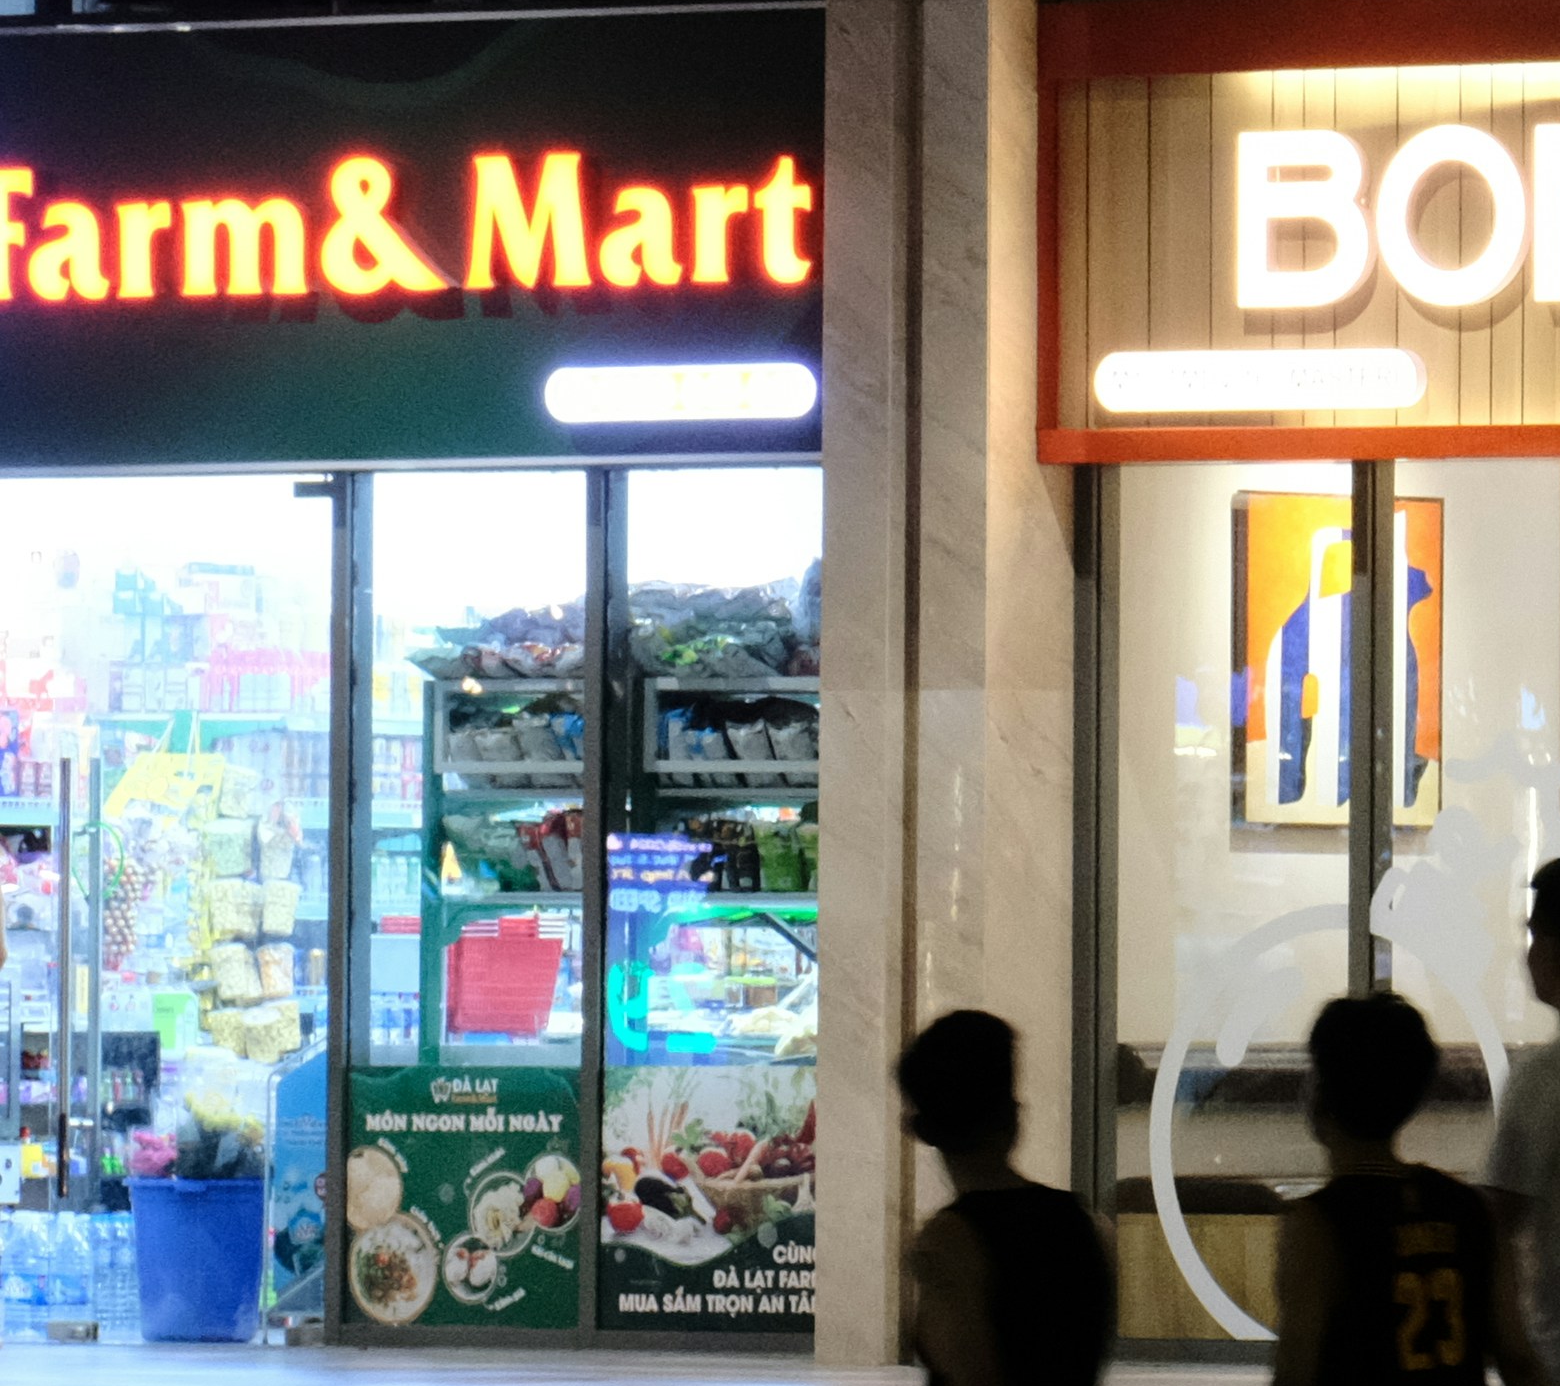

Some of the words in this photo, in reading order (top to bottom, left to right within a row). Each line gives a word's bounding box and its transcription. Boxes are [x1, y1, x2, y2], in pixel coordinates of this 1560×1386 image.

[464, 151, 812, 289] Mart
[366, 1110, 407, 1132] MÓN
[412, 1114, 466, 1132] NGON
[509, 1110, 563, 1132] NGÀY
[773, 1240, 815, 1264] CÙN
[713, 1265, 740, 1289] ĐÀ
[744, 1269, 774, 1293] LẠT
[779, 1269, 815, 1289] FAR
[618, 1293, 659, 1313] MUA
[706, 1294, 753, 1318] TRỌN
[758, 1294, 785, 1313] AN
[789, 1290, 815, 1313] TÂ
